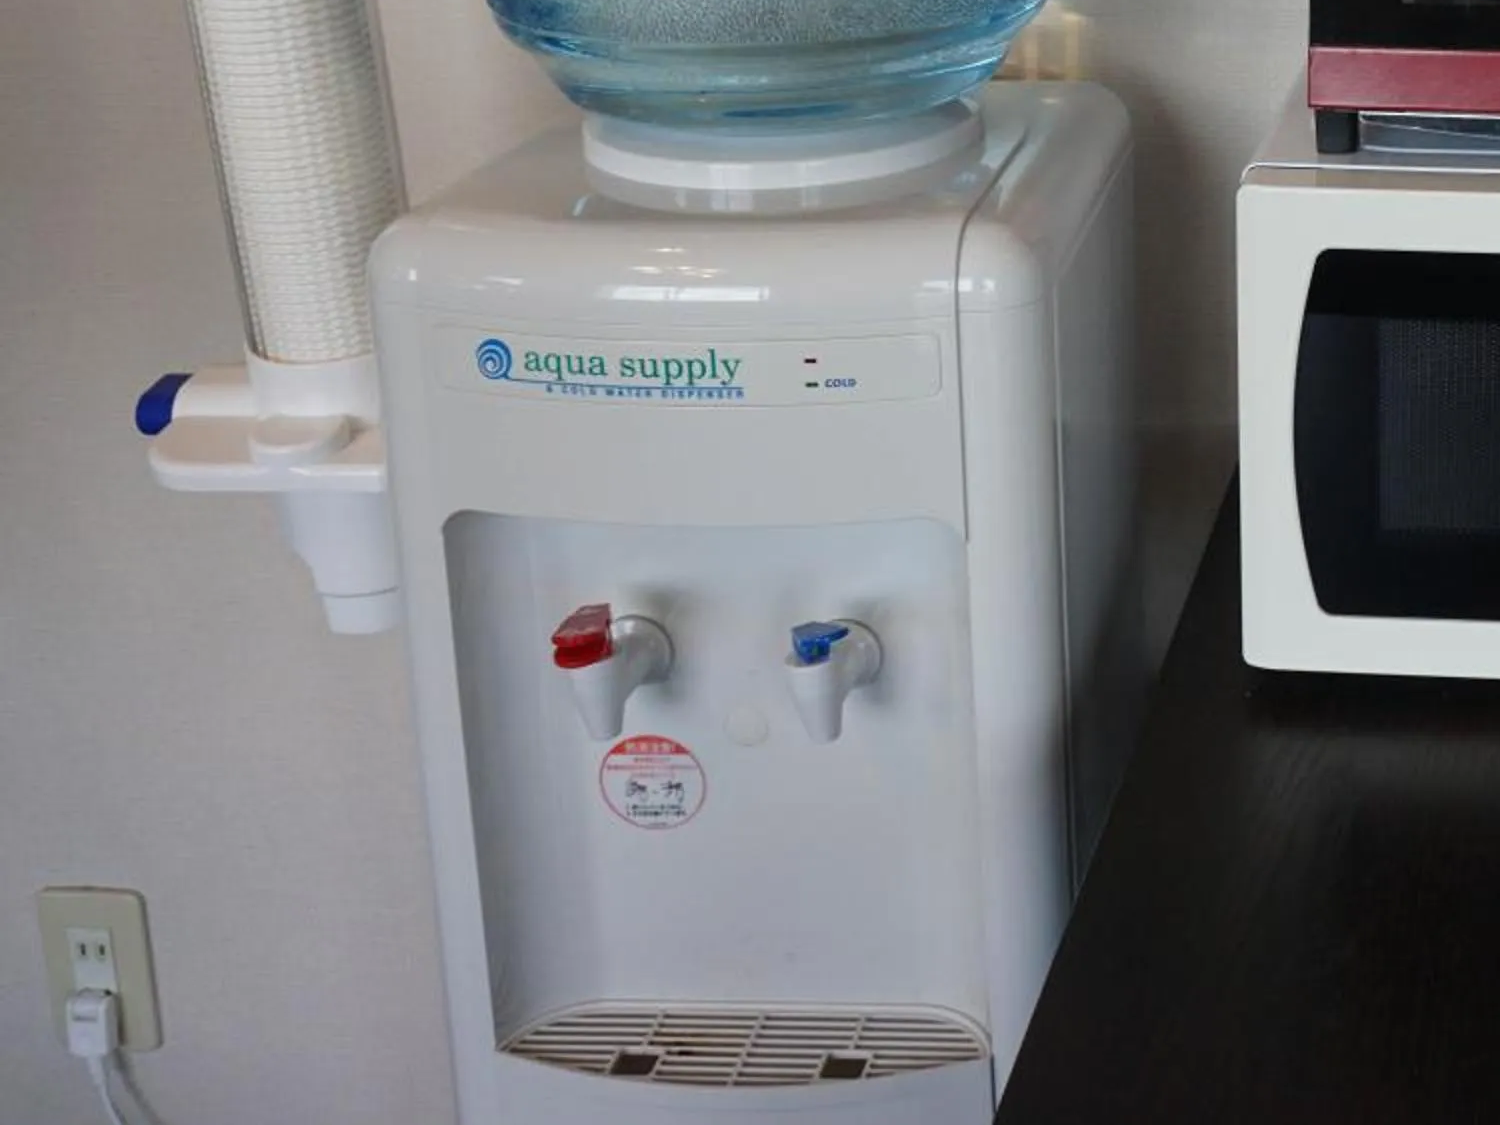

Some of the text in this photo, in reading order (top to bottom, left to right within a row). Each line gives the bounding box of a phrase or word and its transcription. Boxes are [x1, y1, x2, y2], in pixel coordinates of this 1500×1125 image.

[523, 347, 743, 387] aqua supply
[823, 377, 858, 389] COLD
